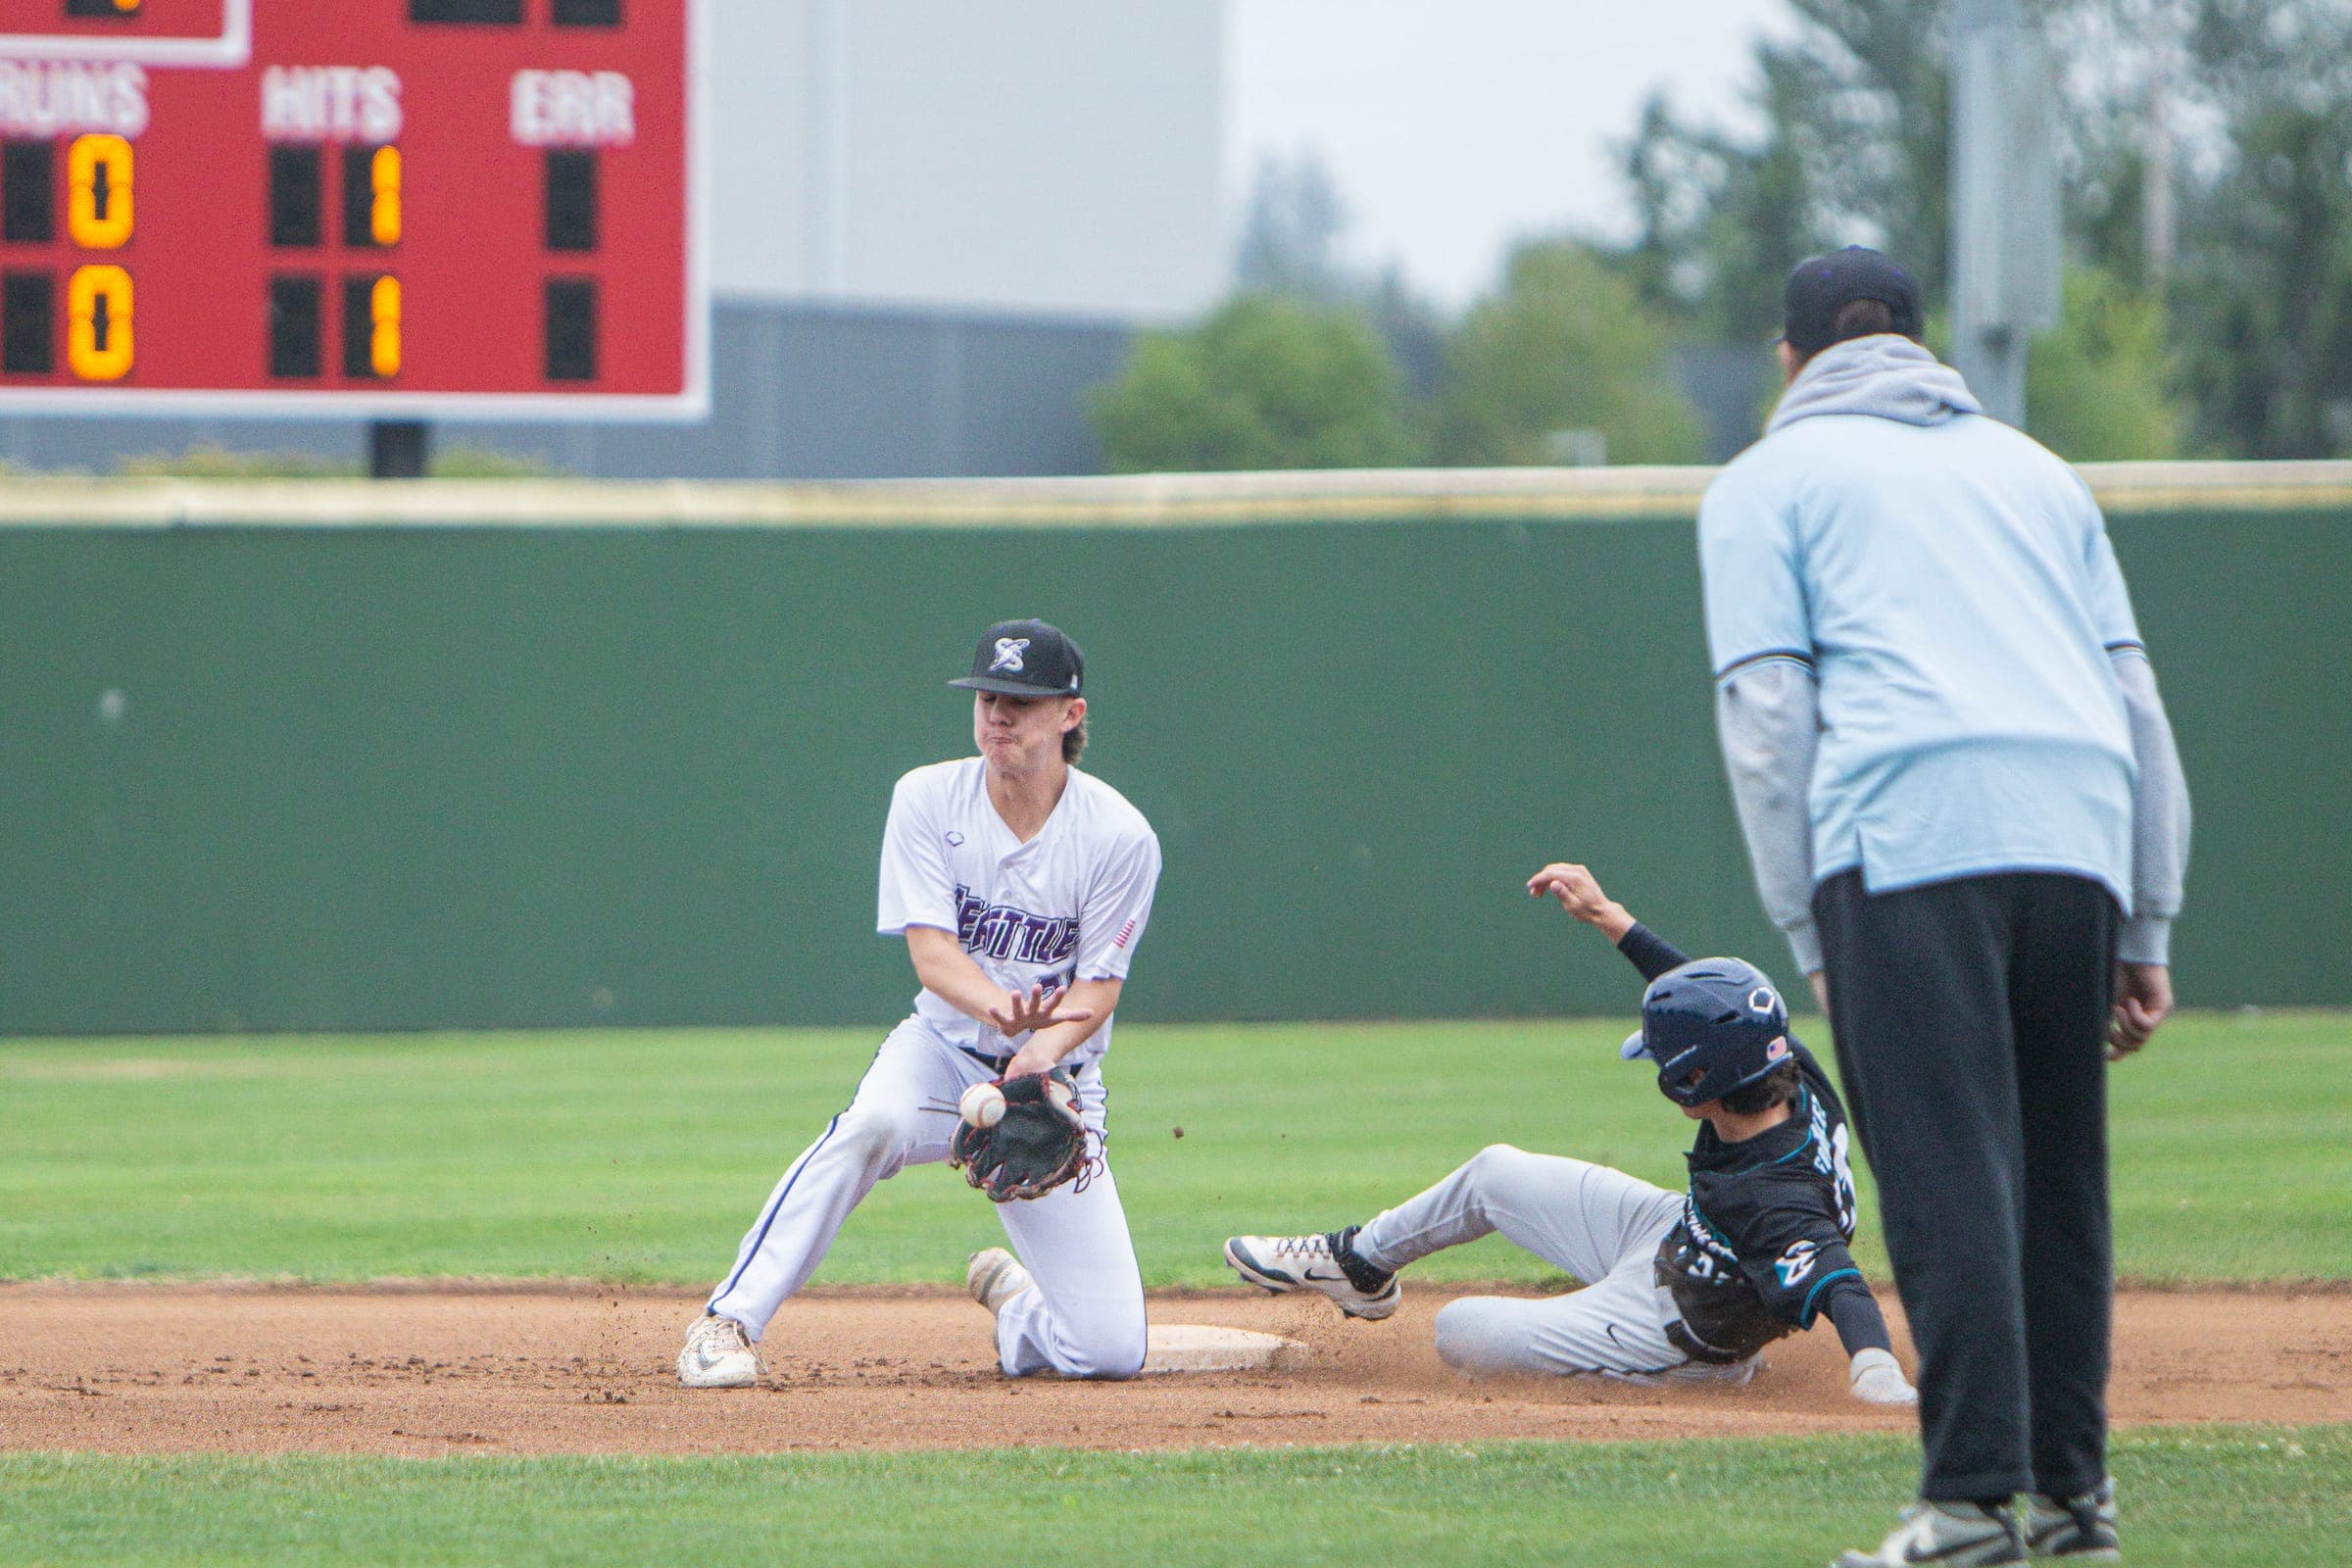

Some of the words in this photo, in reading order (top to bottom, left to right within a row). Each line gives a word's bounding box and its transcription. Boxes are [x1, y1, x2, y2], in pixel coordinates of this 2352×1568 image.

[261, 66, 403, 138] HITS
[511, 69, 635, 143] ERR
[69, 134, 133, 248] 0
[371, 146, 401, 245] 1
[69, 266, 133, 380] 0
[371, 276, 401, 376] 1
